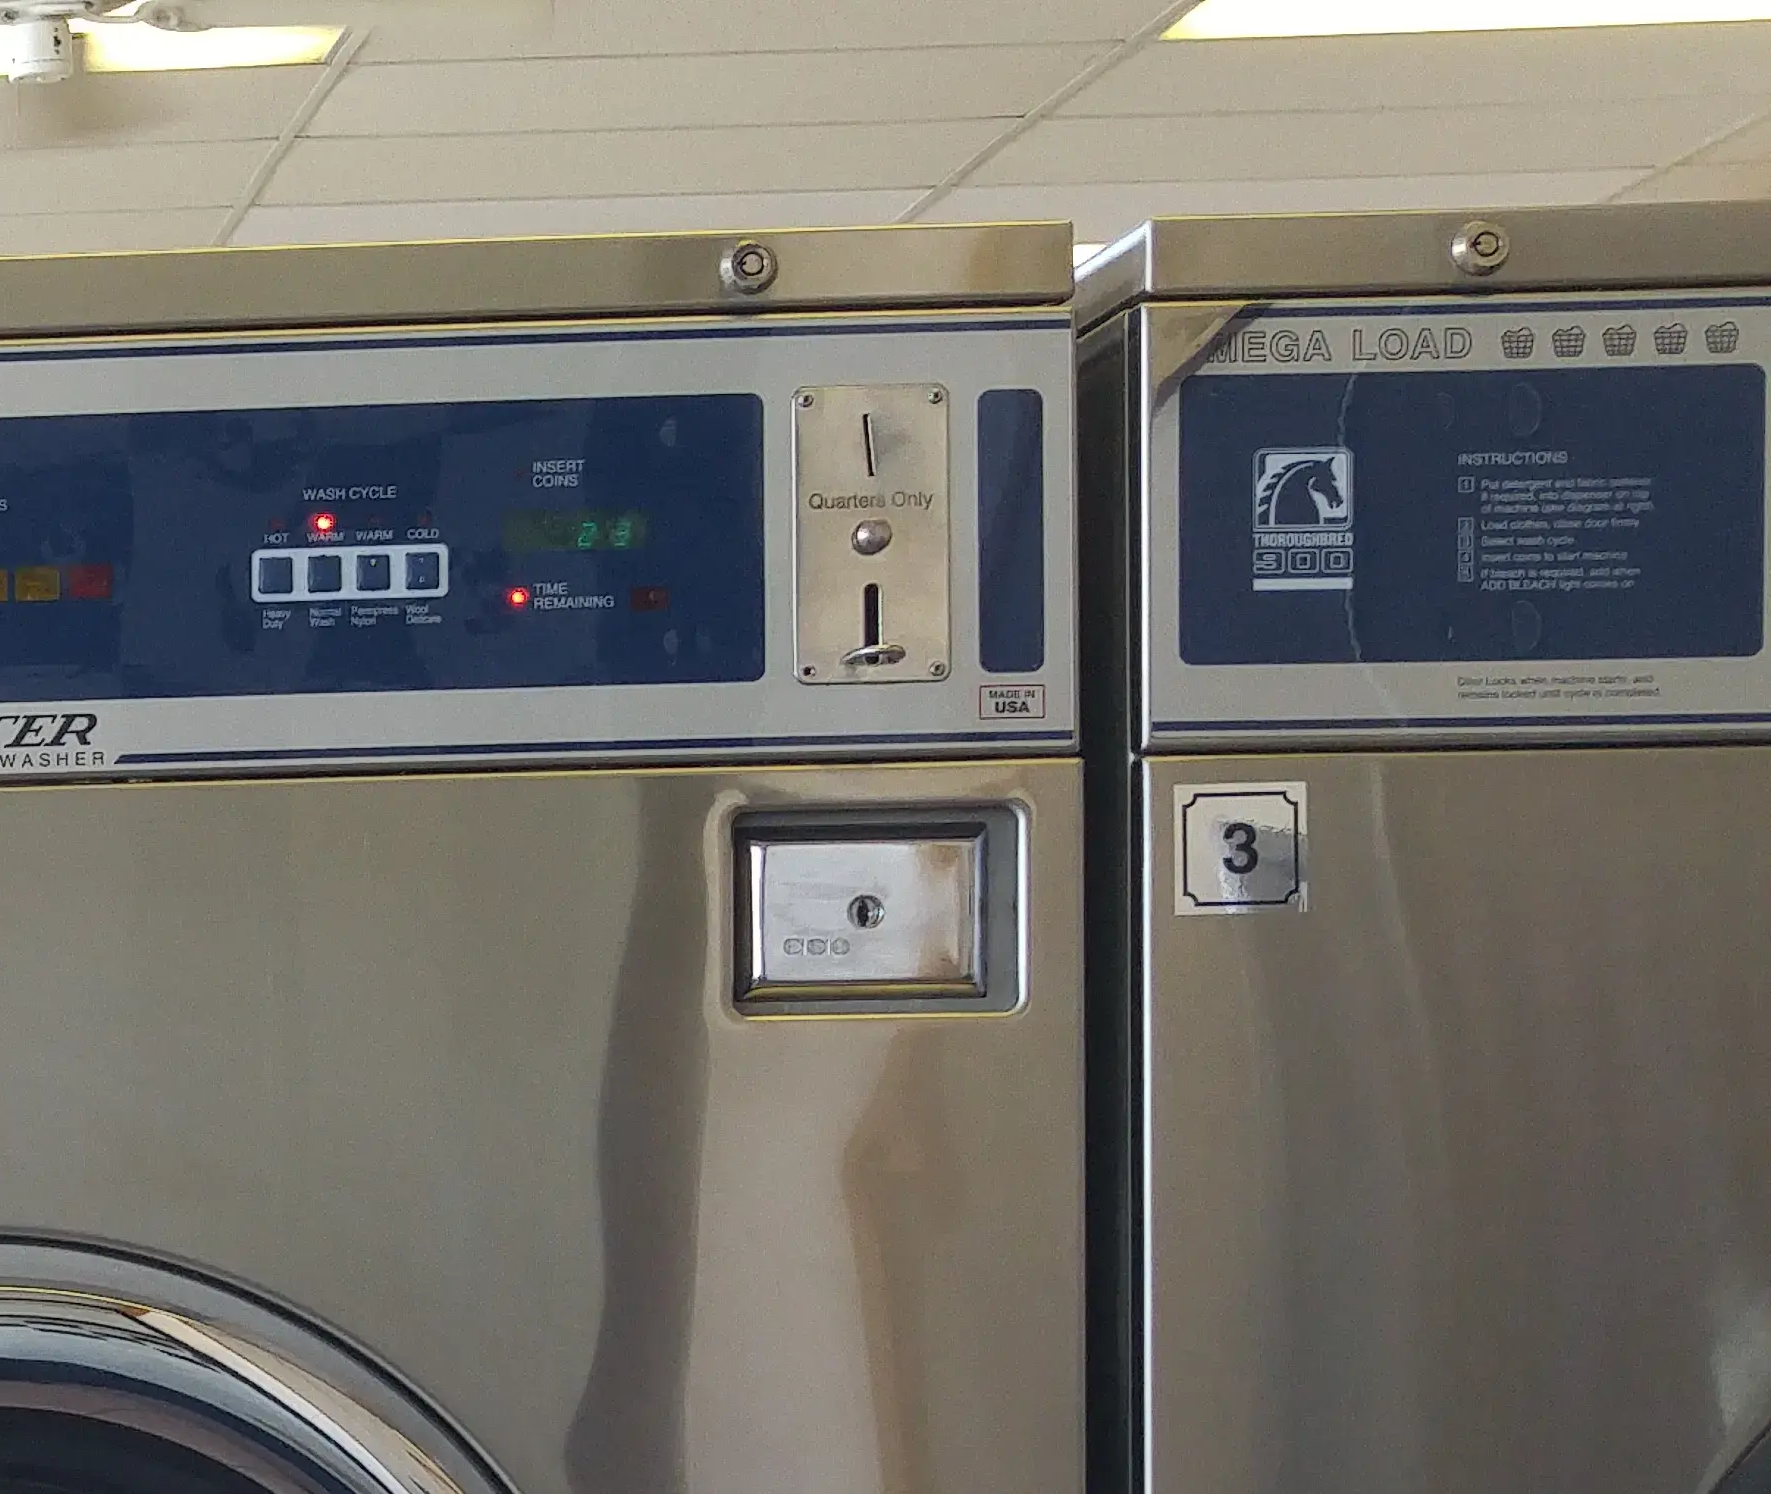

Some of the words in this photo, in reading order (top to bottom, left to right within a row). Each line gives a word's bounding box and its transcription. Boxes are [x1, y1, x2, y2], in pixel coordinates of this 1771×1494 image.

[1209, 330, 1332, 364] MEGA
[1352, 327, 1472, 361] LOAD
[532, 459, 586, 473] INSERT
[1457, 451, 1568, 466] INSTRUCTIONS
[532, 473, 579, 488] COINS
[302, 488, 346, 501] WASH
[348, 486, 398, 499] CYCLE
[808, 492, 886, 511] Quarters
[890, 490, 935, 511] Only
[263, 532, 290, 544] HOT
[307, 531, 345, 543] WARM
[355, 530, 394, 542] WARM
[406, 528, 440, 540] COLD
[1252, 533, 1353, 547] THOROUGHBRED
[533, 582, 568, 595] TIME
[533, 595, 614, 610] REMAINING
[989, 690, 1021, 700] MADE
[1023, 689, 1036, 699] IN
[994, 699, 1031, 714] USA
[0, 751, 106, 769] WASHER
[1221, 822, 1259, 875] 3
